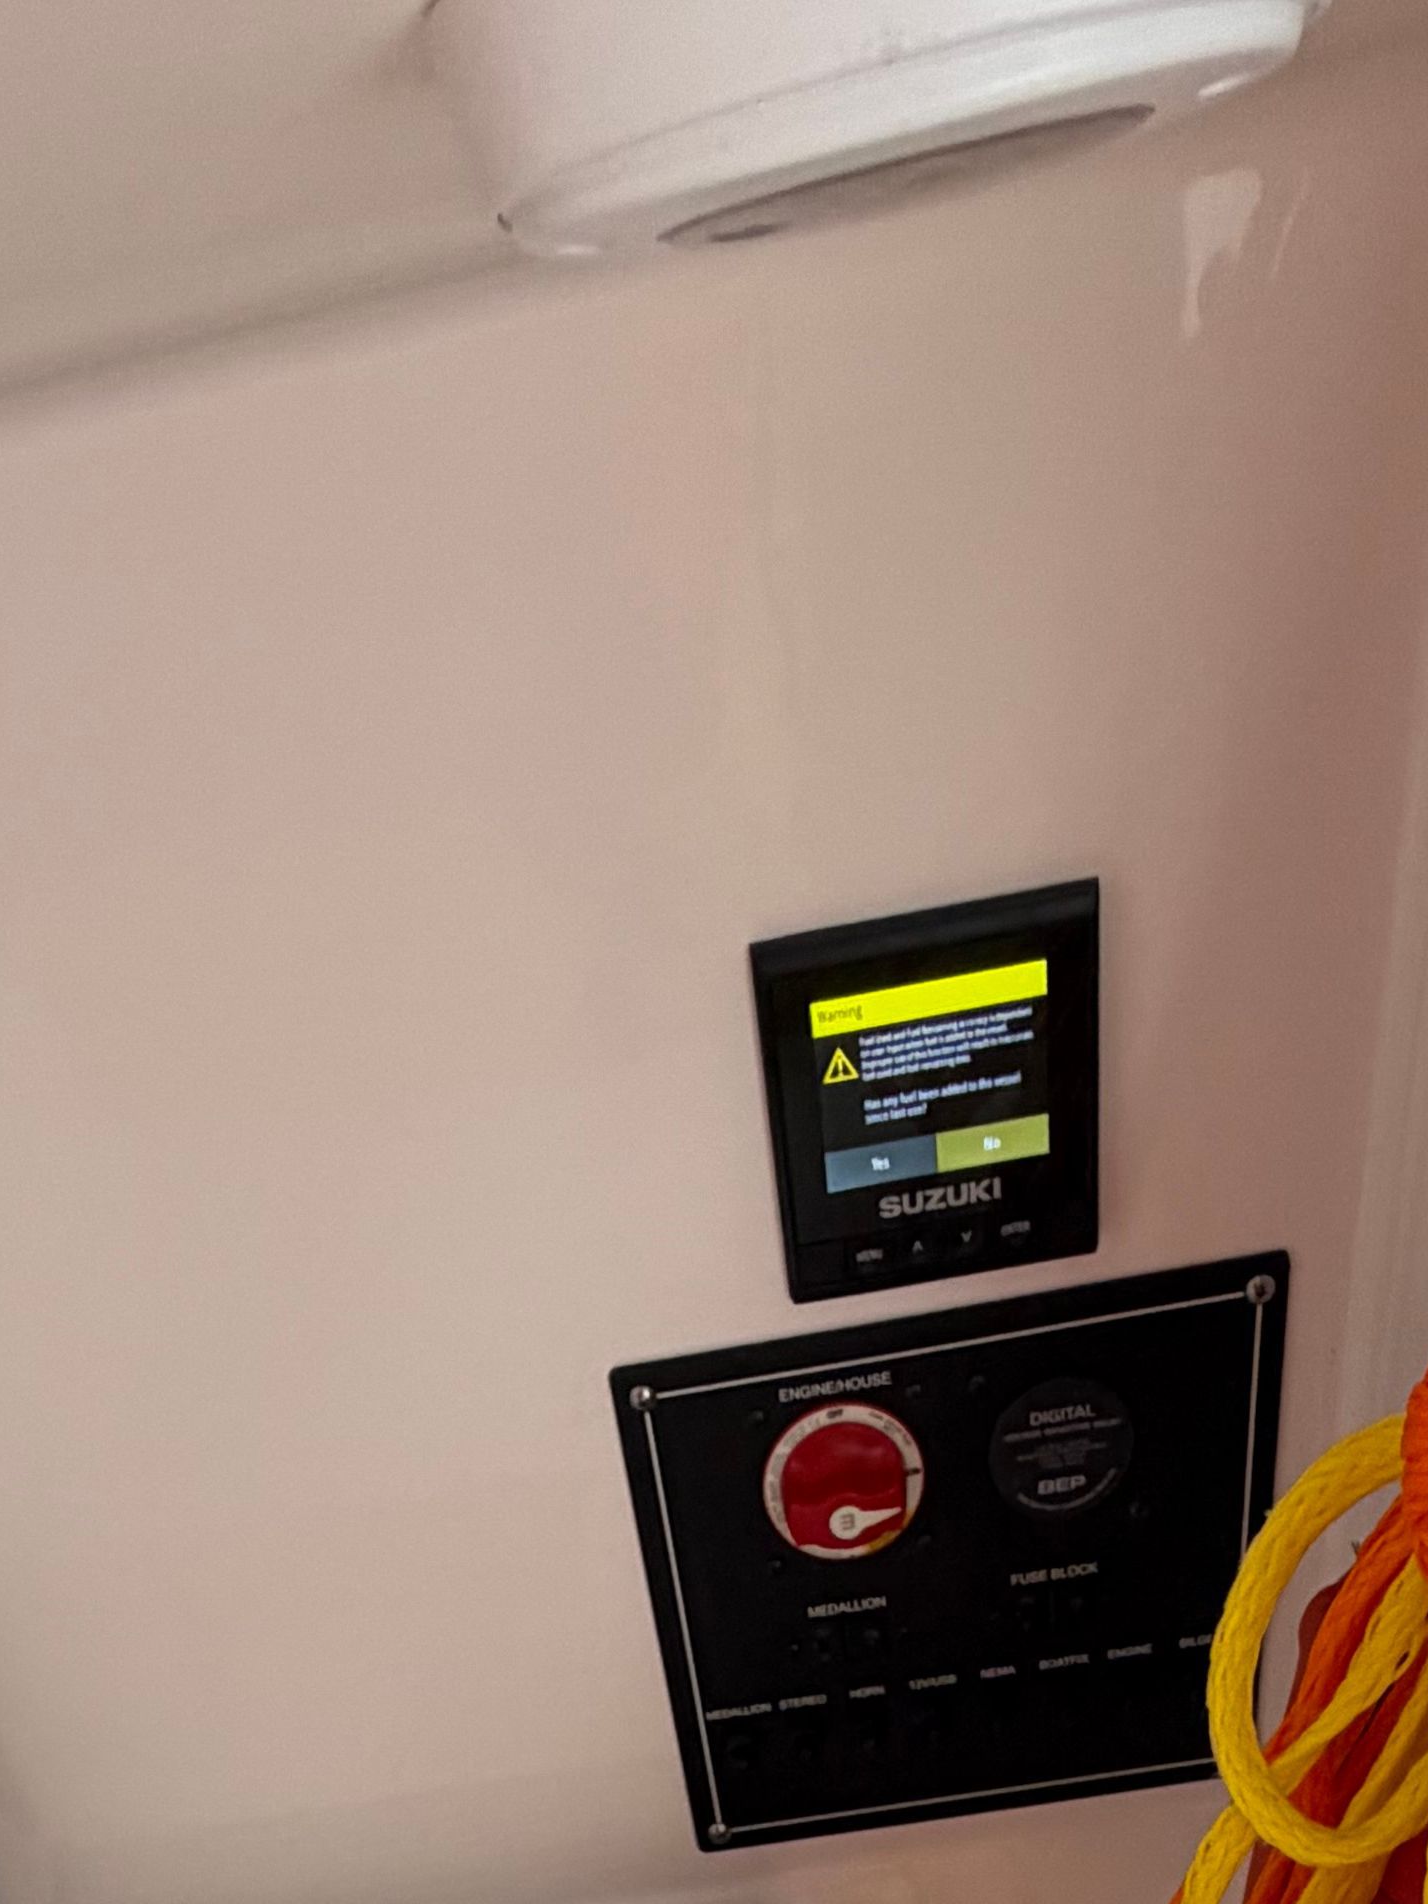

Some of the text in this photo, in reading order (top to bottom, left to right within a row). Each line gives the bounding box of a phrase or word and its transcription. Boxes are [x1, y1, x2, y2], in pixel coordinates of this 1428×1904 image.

[816, 1005, 863, 1023] Warning
[983, 1136, 1002, 1151] No
[871, 1156, 890, 1172] Yes
[878, 1176, 1002, 1219] SUZUKI
[778, 1371, 892, 1403] ENGINE/HOUSE
[1029, 1404, 1096, 1426] DIGITAL
[1037, 1475, 1086, 1495] BEP
[1010, 1562, 1098, 1586] FUSE BLOCK
[807, 1596, 887, 1618] MEDALLION
